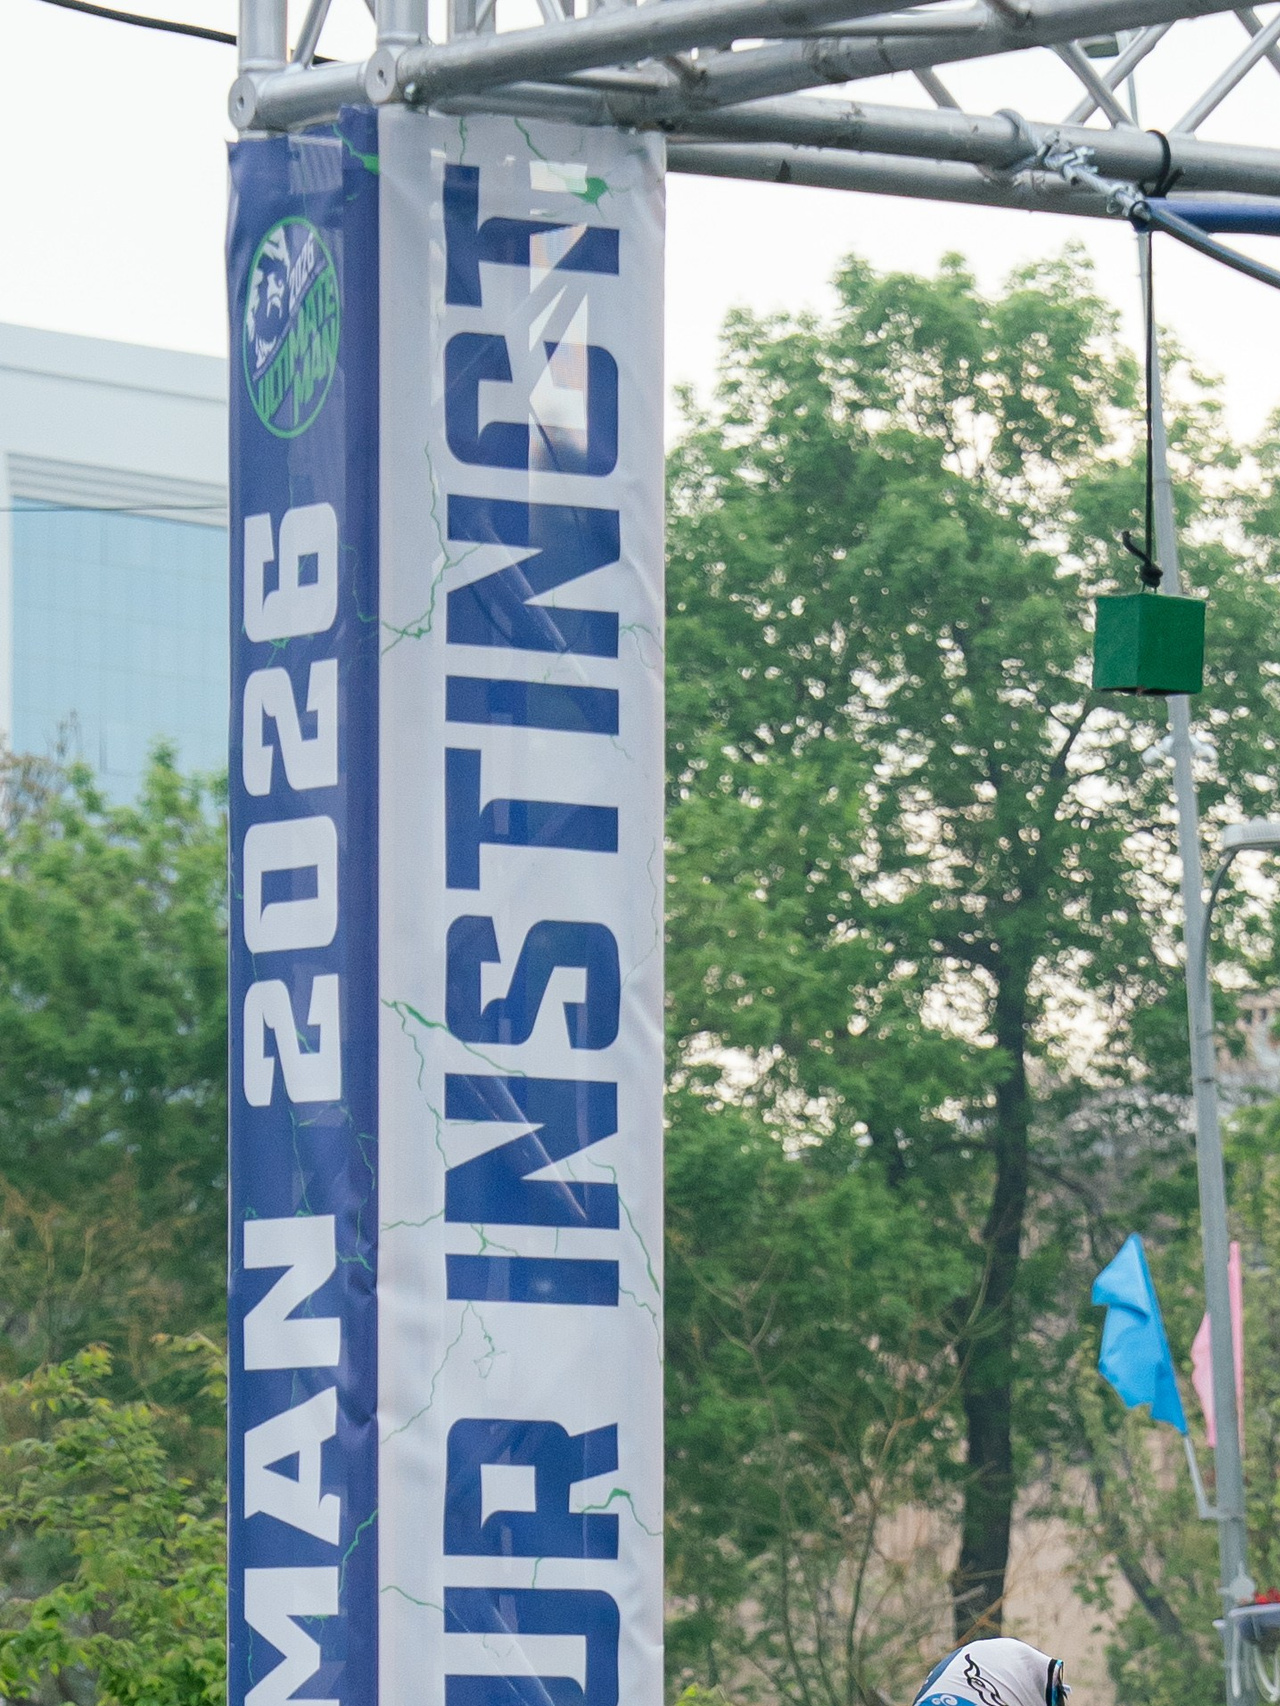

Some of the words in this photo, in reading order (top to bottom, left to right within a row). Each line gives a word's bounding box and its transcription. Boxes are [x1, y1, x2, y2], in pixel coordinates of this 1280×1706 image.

[258, 264, 338, 421] ULTIMATE
[289, 231, 315, 314] 2026
[242, 501, 342, 1108] 2026
[443, 163, 620, 1307] INSTINCT
